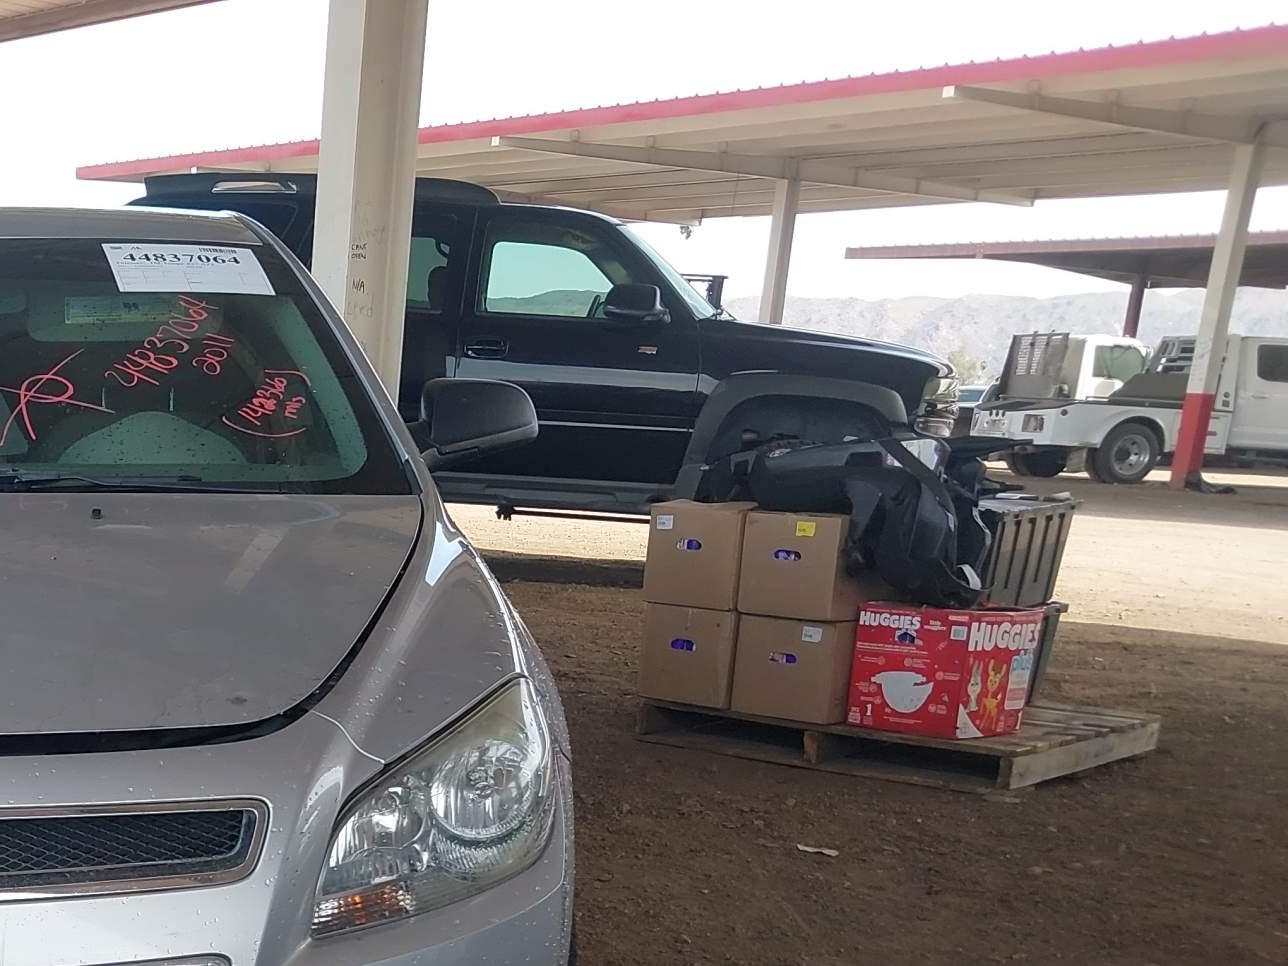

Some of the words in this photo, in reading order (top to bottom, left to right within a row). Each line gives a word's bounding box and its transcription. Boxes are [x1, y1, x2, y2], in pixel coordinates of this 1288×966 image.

[123, 253, 241, 265] 44837064
[192, 332, 235, 376] 2011
[858, 610, 921, 630] HUGGIES
[968, 622, 1041, 651] HUGGIES
